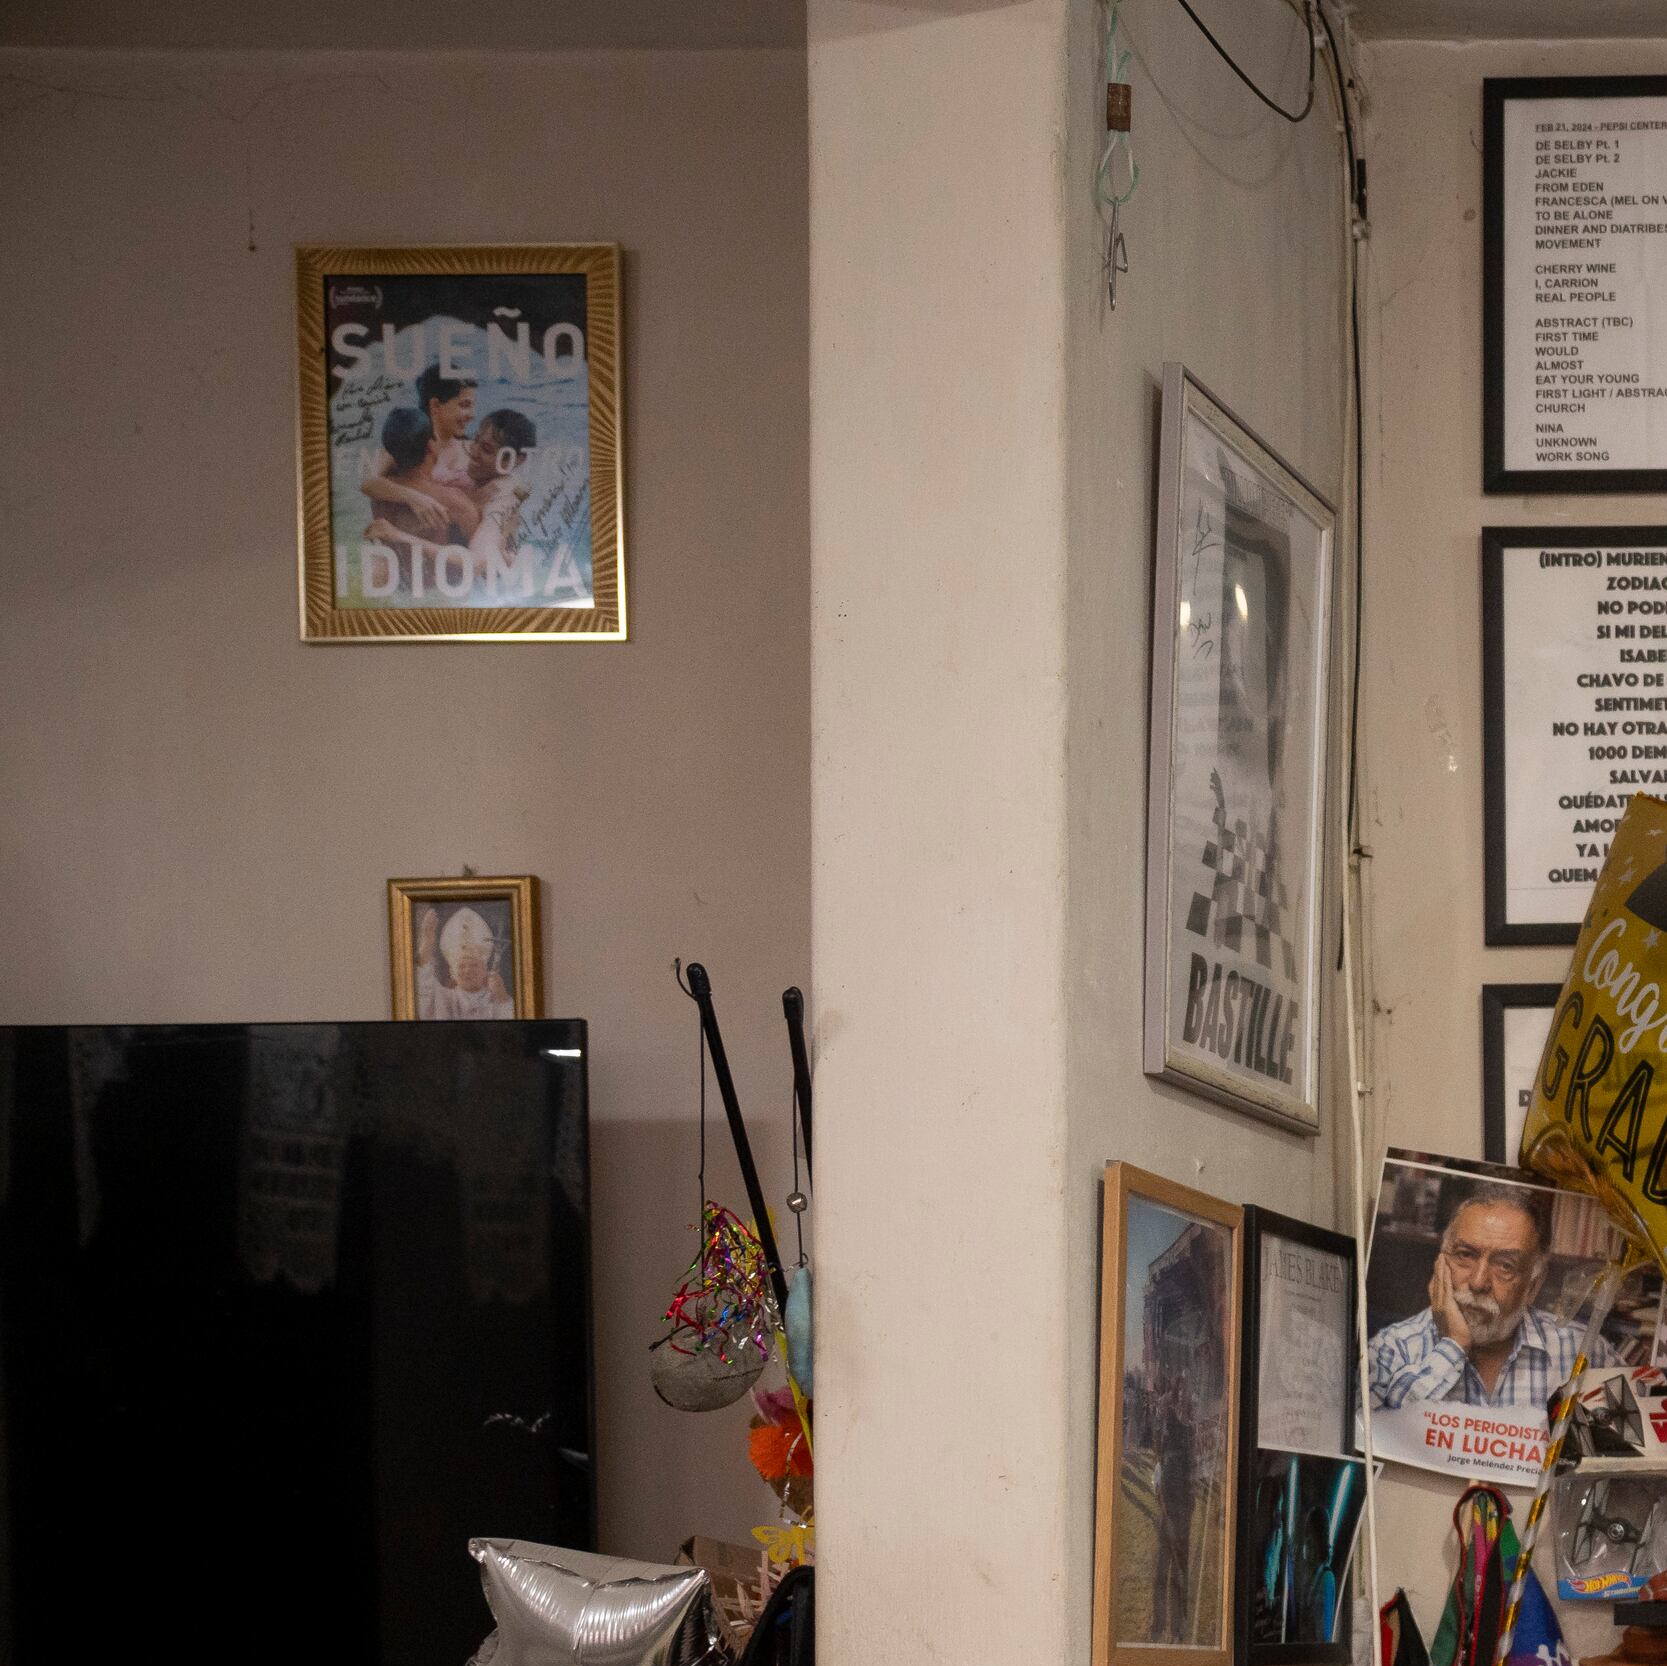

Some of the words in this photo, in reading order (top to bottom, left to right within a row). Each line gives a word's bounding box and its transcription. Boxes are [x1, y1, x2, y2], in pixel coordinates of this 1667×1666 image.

[1534, 167, 1577, 179] JACKIE
[1534, 264, 1583, 274] CHERRY
[1585, 263, 1616, 273] WINE
[331, 306, 586, 381] SUEÑO
[1535, 451, 1573, 462] WORK
[1575, 451, 1610, 461] SONG
[337, 543, 586, 599] IDIOMA
[1184, 952, 1299, 1086] BASTILLE
[1425, 1428, 1455, 1450] EN
[1464, 1417, 1550, 1441] PERIODISTA
[1447, 1454, 1471, 1465] Jorge
[1473, 1457, 1514, 1471] Meléndez
[1516, 1464, 1543, 1475] Precia
